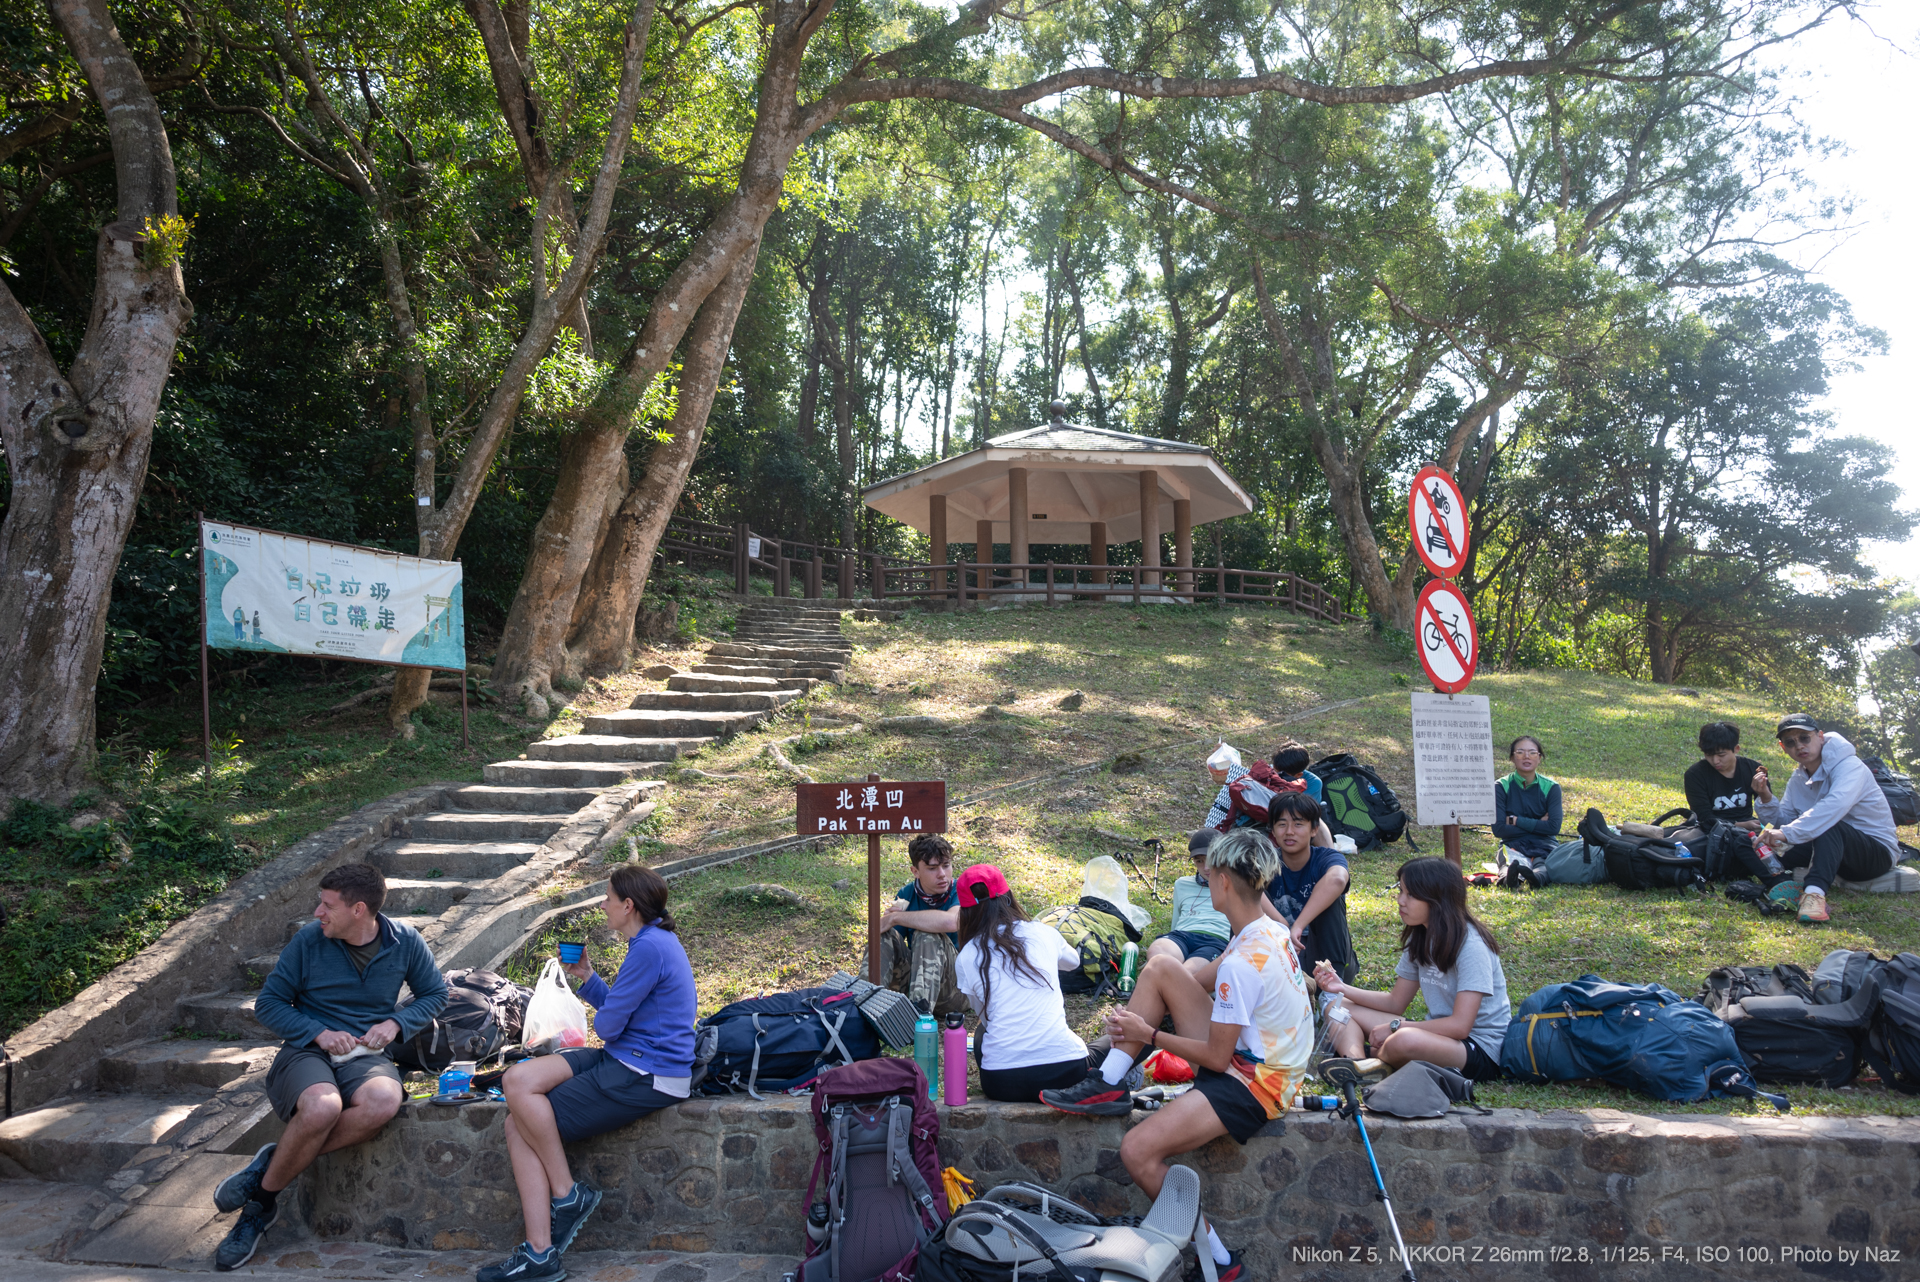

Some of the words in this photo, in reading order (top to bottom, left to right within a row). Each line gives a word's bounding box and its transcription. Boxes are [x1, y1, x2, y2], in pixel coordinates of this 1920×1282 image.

[286, 567, 390, 603] 自己垃圾
[294, 604, 395, 630] 自己帶走
[836, 785, 904, 812] 北潭凹
[818, 817, 848, 831] Pak
[856, 816, 890, 830] Tam
[901, 816, 922, 830] Au
